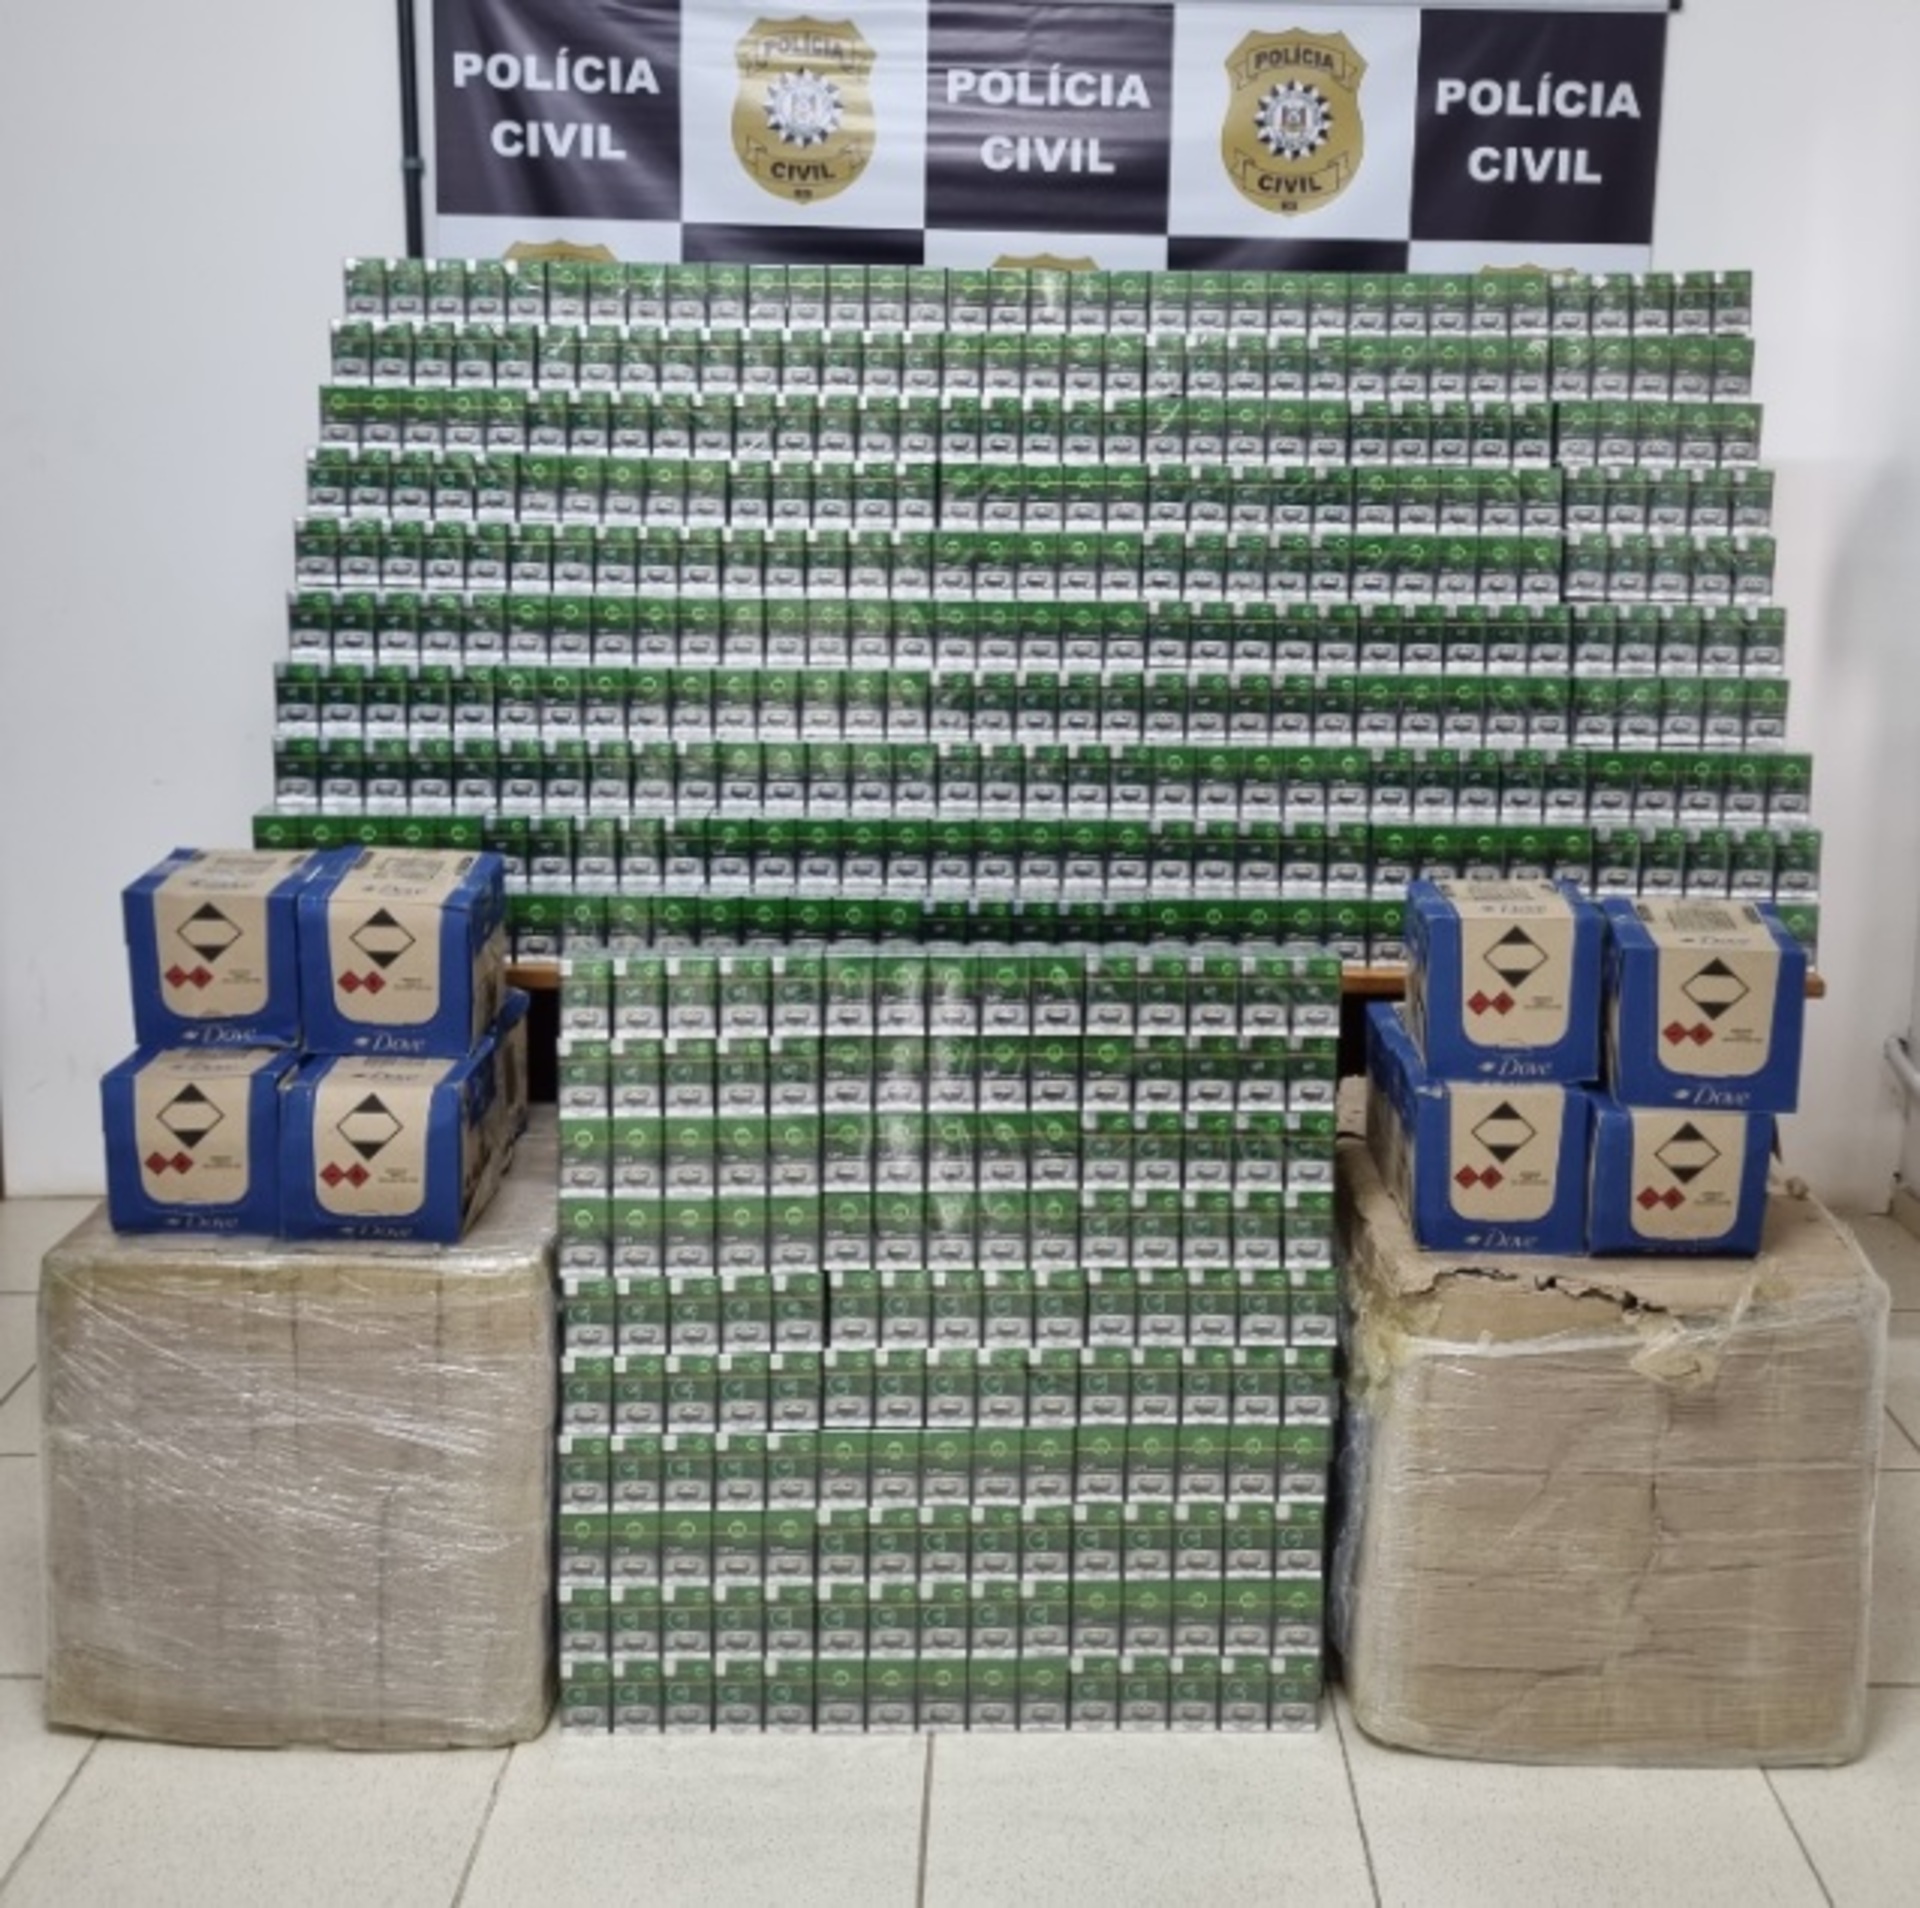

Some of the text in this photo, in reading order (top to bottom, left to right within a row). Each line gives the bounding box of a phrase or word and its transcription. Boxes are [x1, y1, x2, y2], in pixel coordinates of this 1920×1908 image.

[1254, 42, 1335, 69] POLÍCIA
[453, 48, 660, 95] POLÍCIA
[946, 63, 1151, 109] POLÍCIA
[1436, 73, 1641, 118] POLÍCIA
[491, 121, 627, 160] CIVIL
[980, 136, 1115, 174] CIVIL
[1467, 146, 1602, 183] CIVIL
[770, 162, 836, 182] CIVIL
[1257, 174, 1322, 194] CIVIL
[204, 1025, 257, 1043] Dove
[371, 1033, 426, 1052] Dove
[1497, 1055, 1552, 1076] Dove
[1692, 1084, 1750, 1106] Dove
[1480, 1228, 1538, 1249] Dove
